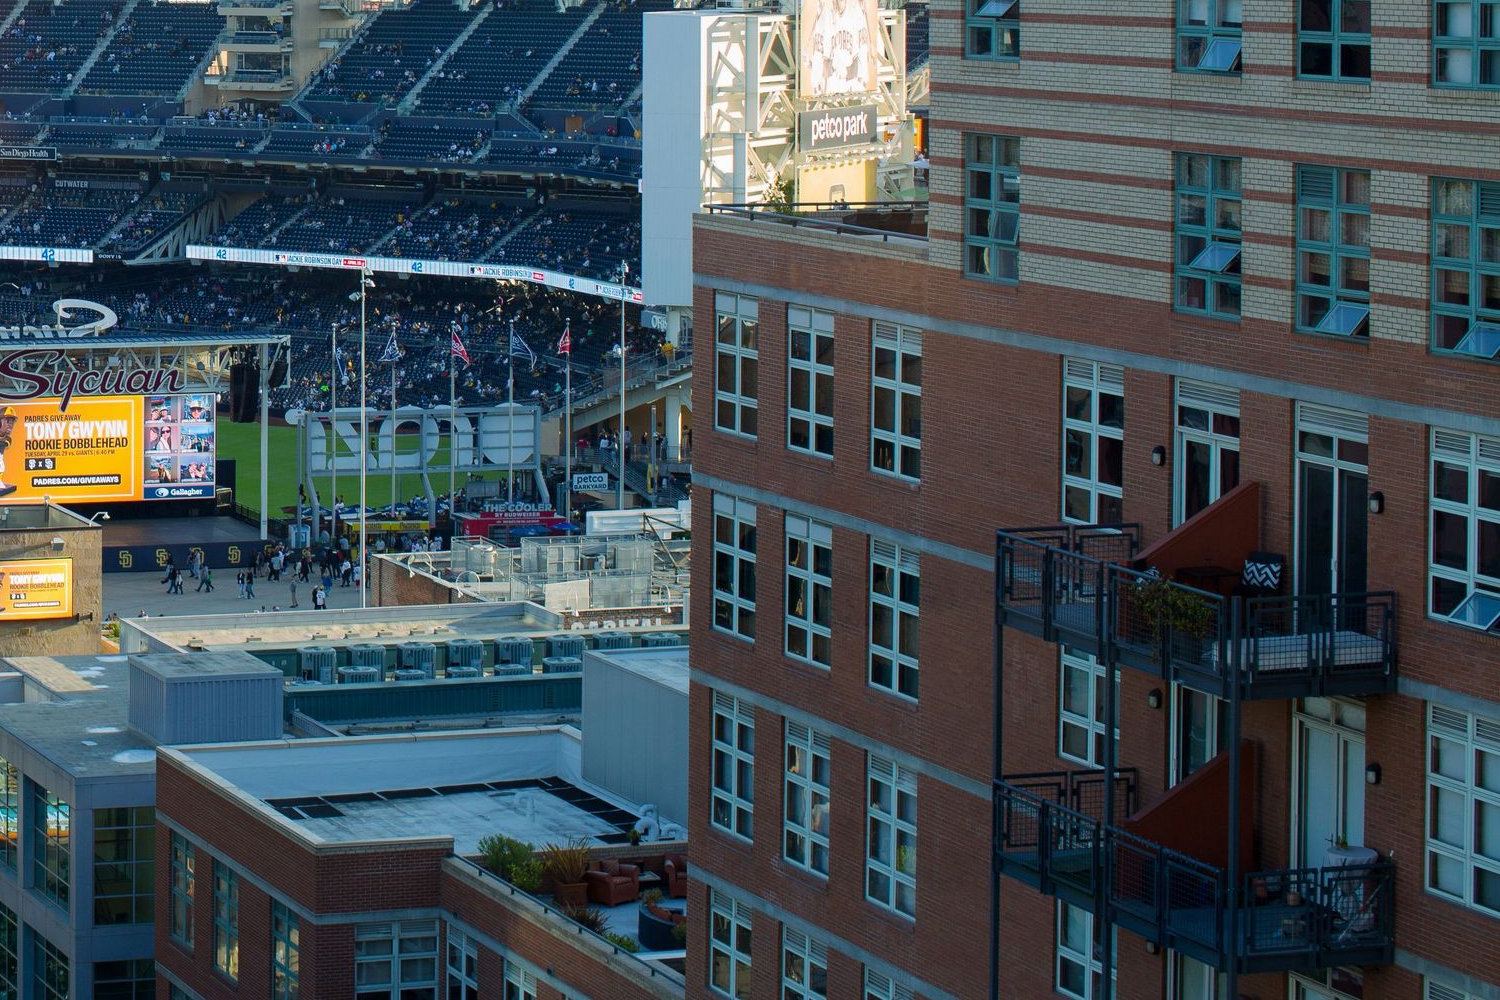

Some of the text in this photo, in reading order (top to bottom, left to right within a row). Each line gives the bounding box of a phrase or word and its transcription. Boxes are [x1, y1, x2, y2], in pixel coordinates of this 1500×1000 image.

[812, 112, 868, 146] petco park
[0, 148, 12, 157] San
[12, 149, 29, 158] Diego
[29, 149, 49, 158] Health
[55, 180, 88, 188] CUTWATER
[42, 249, 54, 261] 42
[216, 249, 227, 260] 42
[288, 255, 342, 265] JACKIE ROBINSON DAY
[411, 262, 422, 272] 42
[25, 420, 128, 439] TONY GWYNN
[25, 437, 128, 450] ROOKIE BOBBLEHEAD
[33, 476, 119, 485] PADRES.COM/GIVEAWAYS
[577, 475, 604, 484] petco
[170, 488, 203, 496] Gallagher
[508, 503, 552, 511] COOLER
